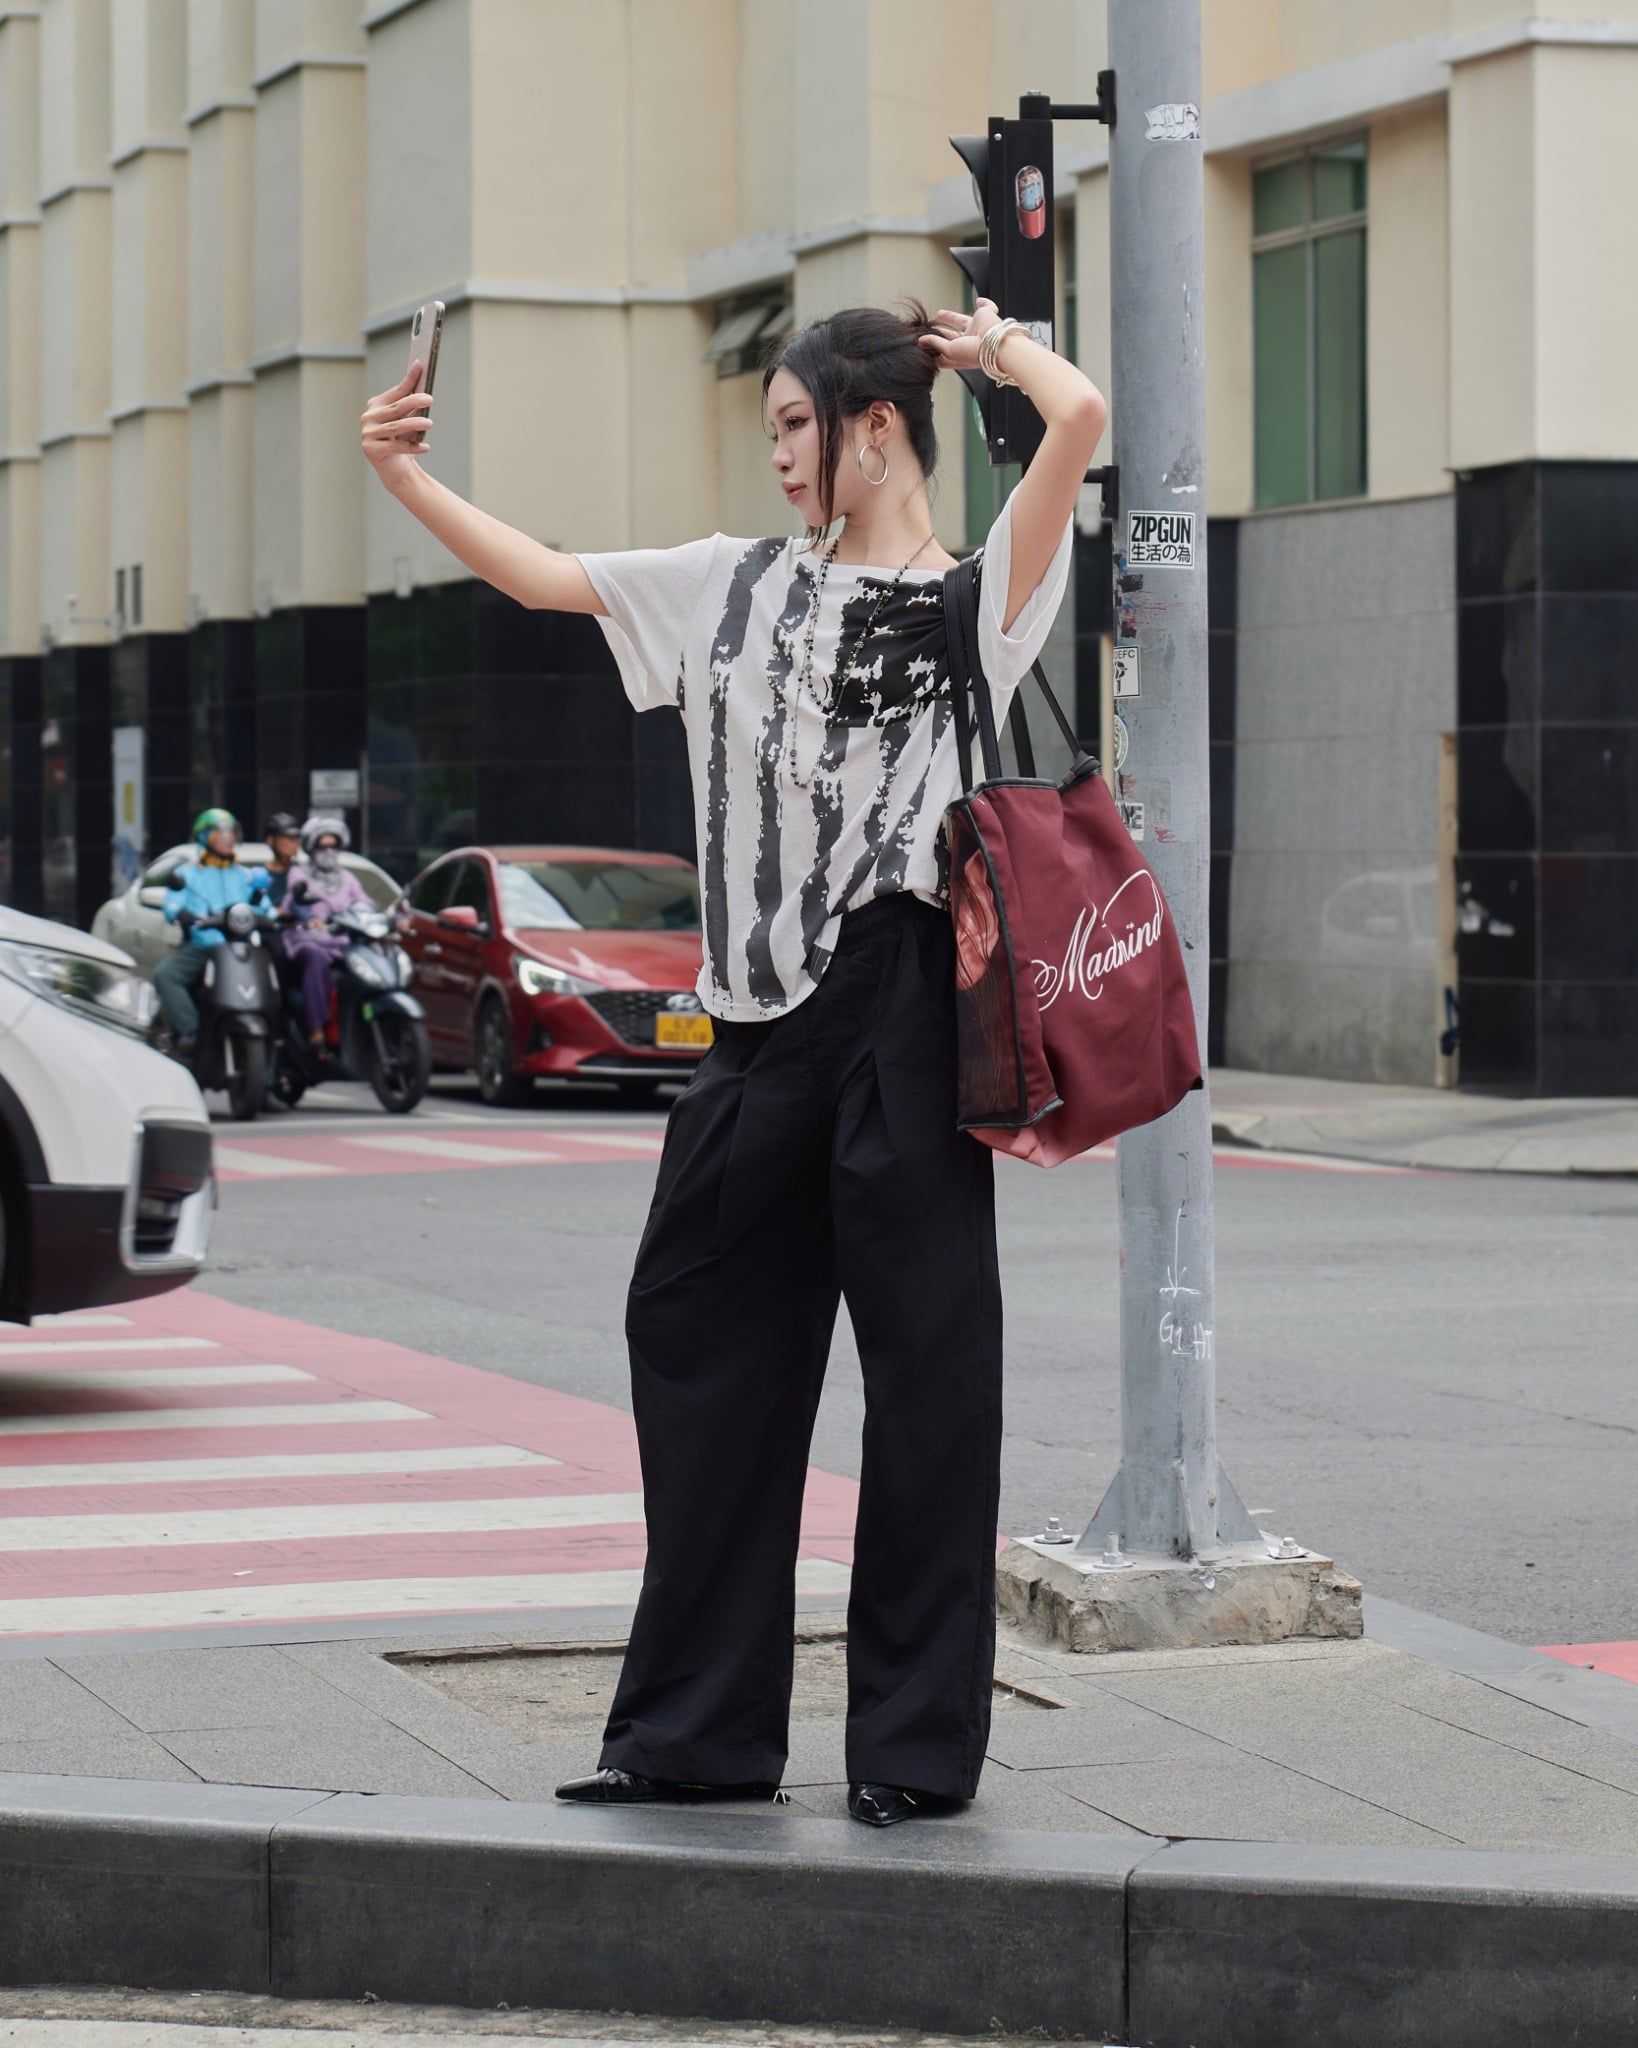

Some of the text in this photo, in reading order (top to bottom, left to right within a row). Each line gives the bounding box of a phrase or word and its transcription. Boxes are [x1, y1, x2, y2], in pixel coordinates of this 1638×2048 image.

[1131, 515, 1191, 543] ZIPGUN
[1131, 543, 1191, 563] 生活の為
